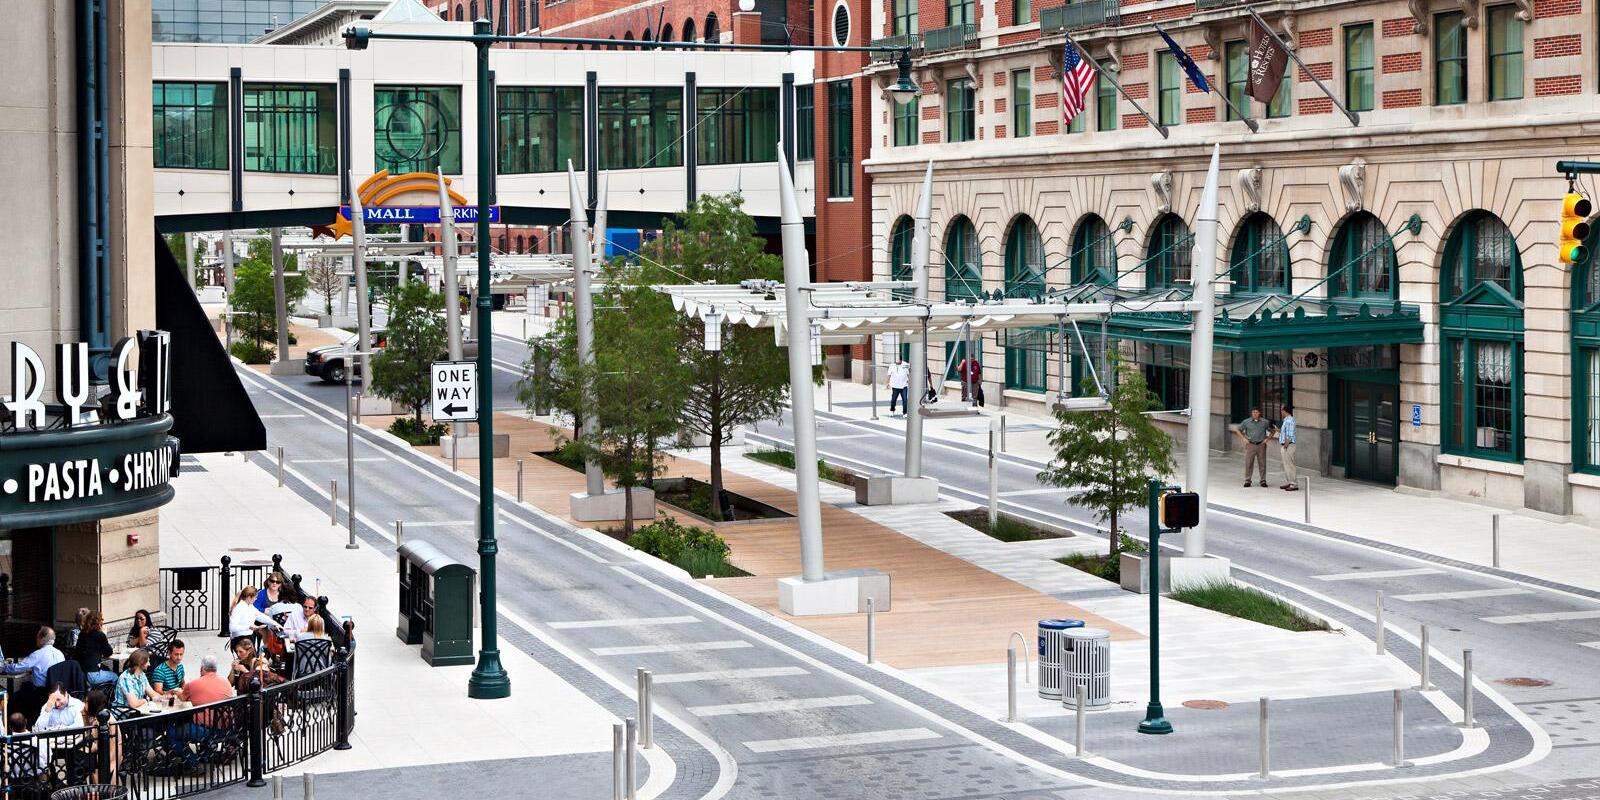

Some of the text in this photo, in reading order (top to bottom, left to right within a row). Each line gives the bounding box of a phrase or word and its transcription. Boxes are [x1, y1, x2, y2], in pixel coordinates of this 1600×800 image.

[367, 208, 414, 219] MALL
[438, 369, 470, 382] ONE
[4, 341, 89, 428] RY
[114, 337, 142, 420] &
[437, 387, 471, 400] WAY
[29, 446, 172, 503] PASTA SHRIMP
